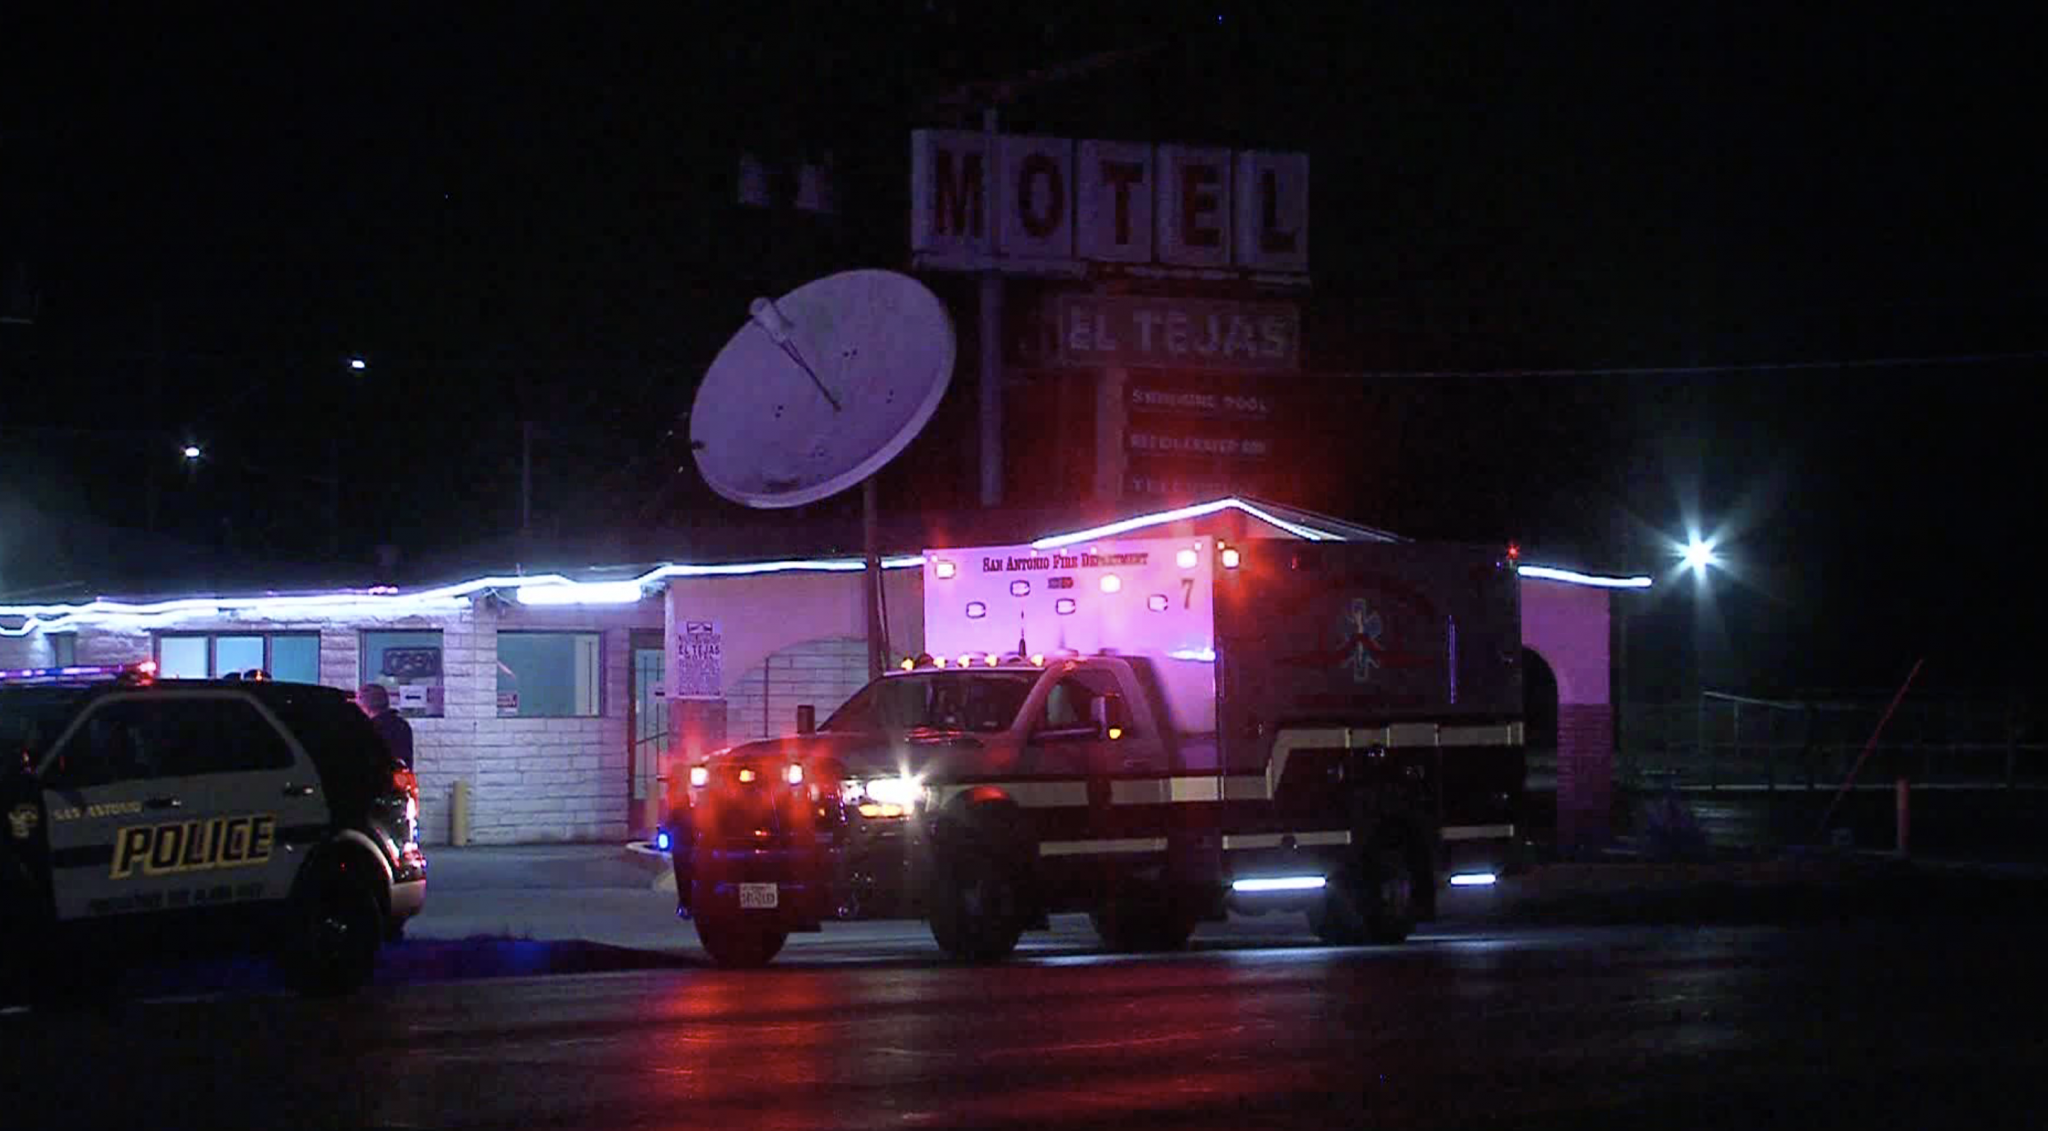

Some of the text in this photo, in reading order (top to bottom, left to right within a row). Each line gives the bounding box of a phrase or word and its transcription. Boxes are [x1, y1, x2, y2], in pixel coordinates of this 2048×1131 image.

[936, 151, 1295, 251] MOTEL
[1070, 306, 1287, 358] EL TEJAS
[983, 551, 1149, 573] SAN ANTONIO FIRE DEPARTMENT
[1180, 578, 1194, 610] 7
[110, 814, 276, 880] POLICE
